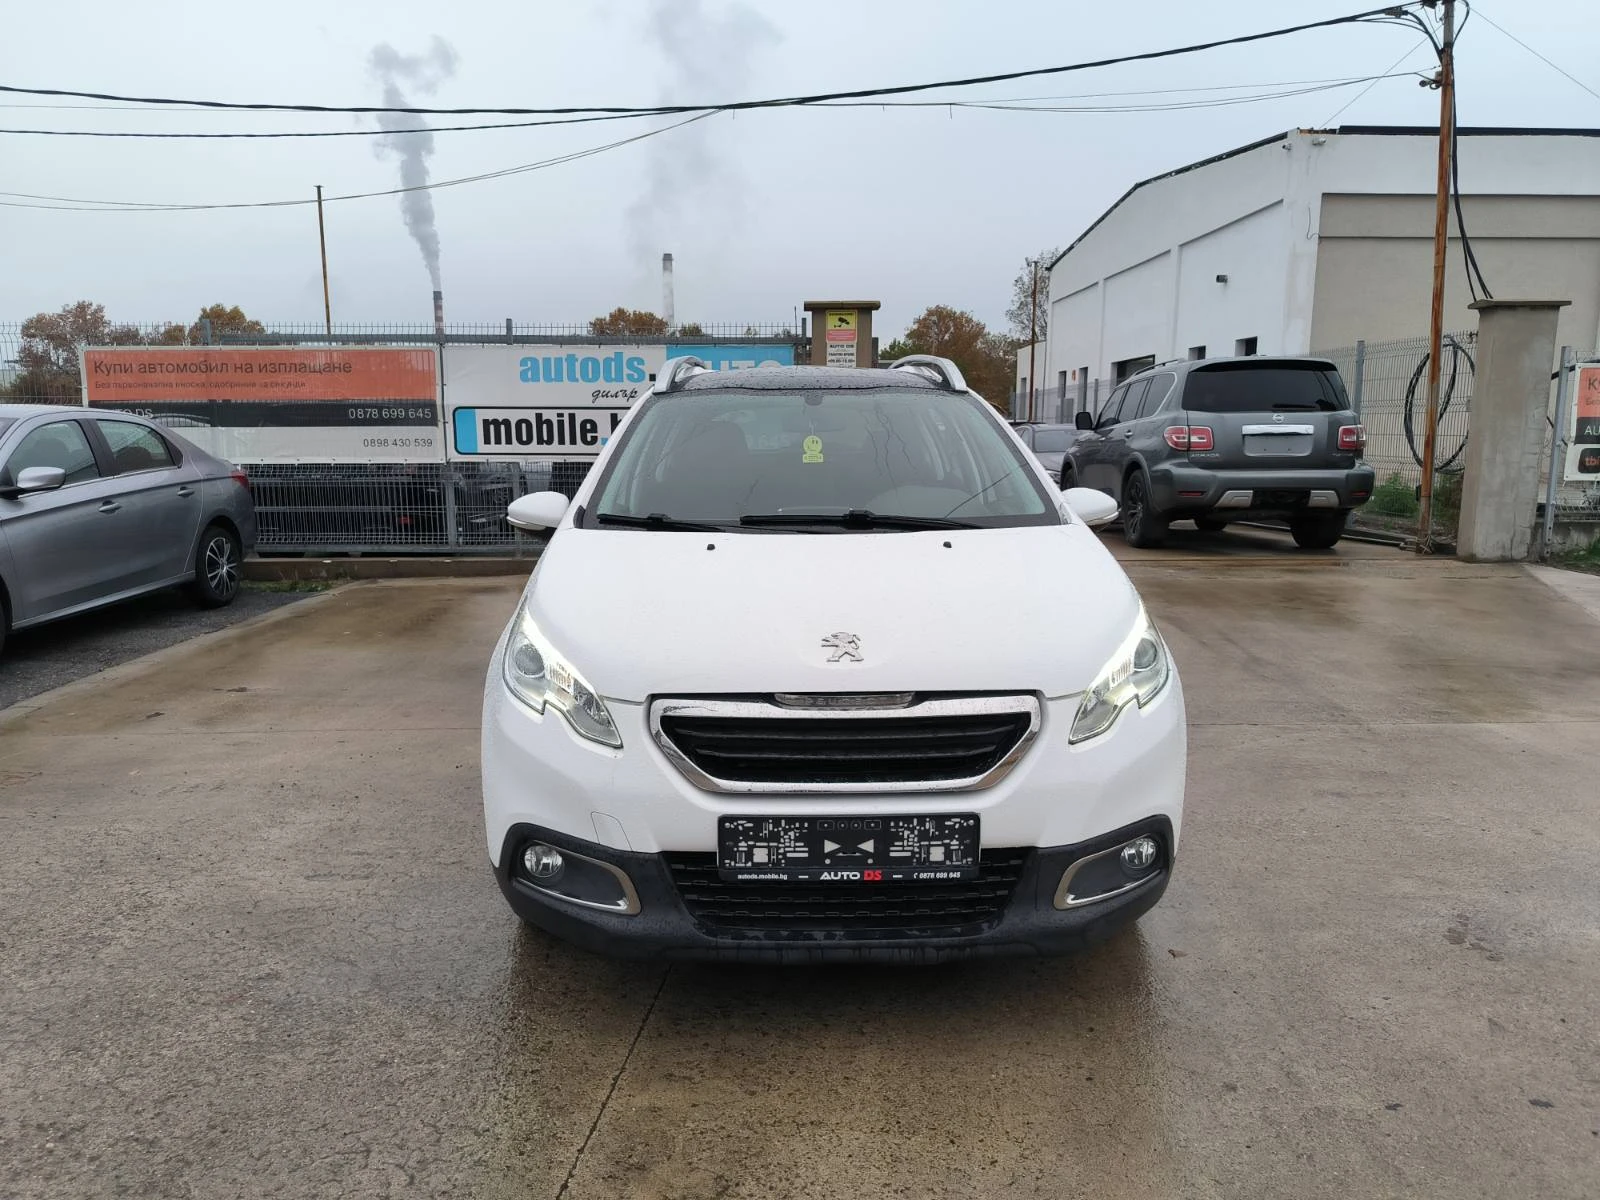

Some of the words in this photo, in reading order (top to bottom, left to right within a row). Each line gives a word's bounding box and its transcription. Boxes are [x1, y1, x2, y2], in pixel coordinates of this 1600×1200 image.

[94, 360, 133, 376] Купи
[138, 360, 228, 375] автомобил
[233, 361, 253, 374] на
[258, 361, 353, 375] изплащане
[348, 408, 379, 419] 0878
[382, 408, 405, 419] 699
[408, 408, 432, 419] 645
[363, 438, 390, 448] 0898
[391, 438, 411, 448] 430
[414, 438, 433, 448] 539
[819, 871, 861, 880] AUTO
[863, 870, 882, 880] DS
